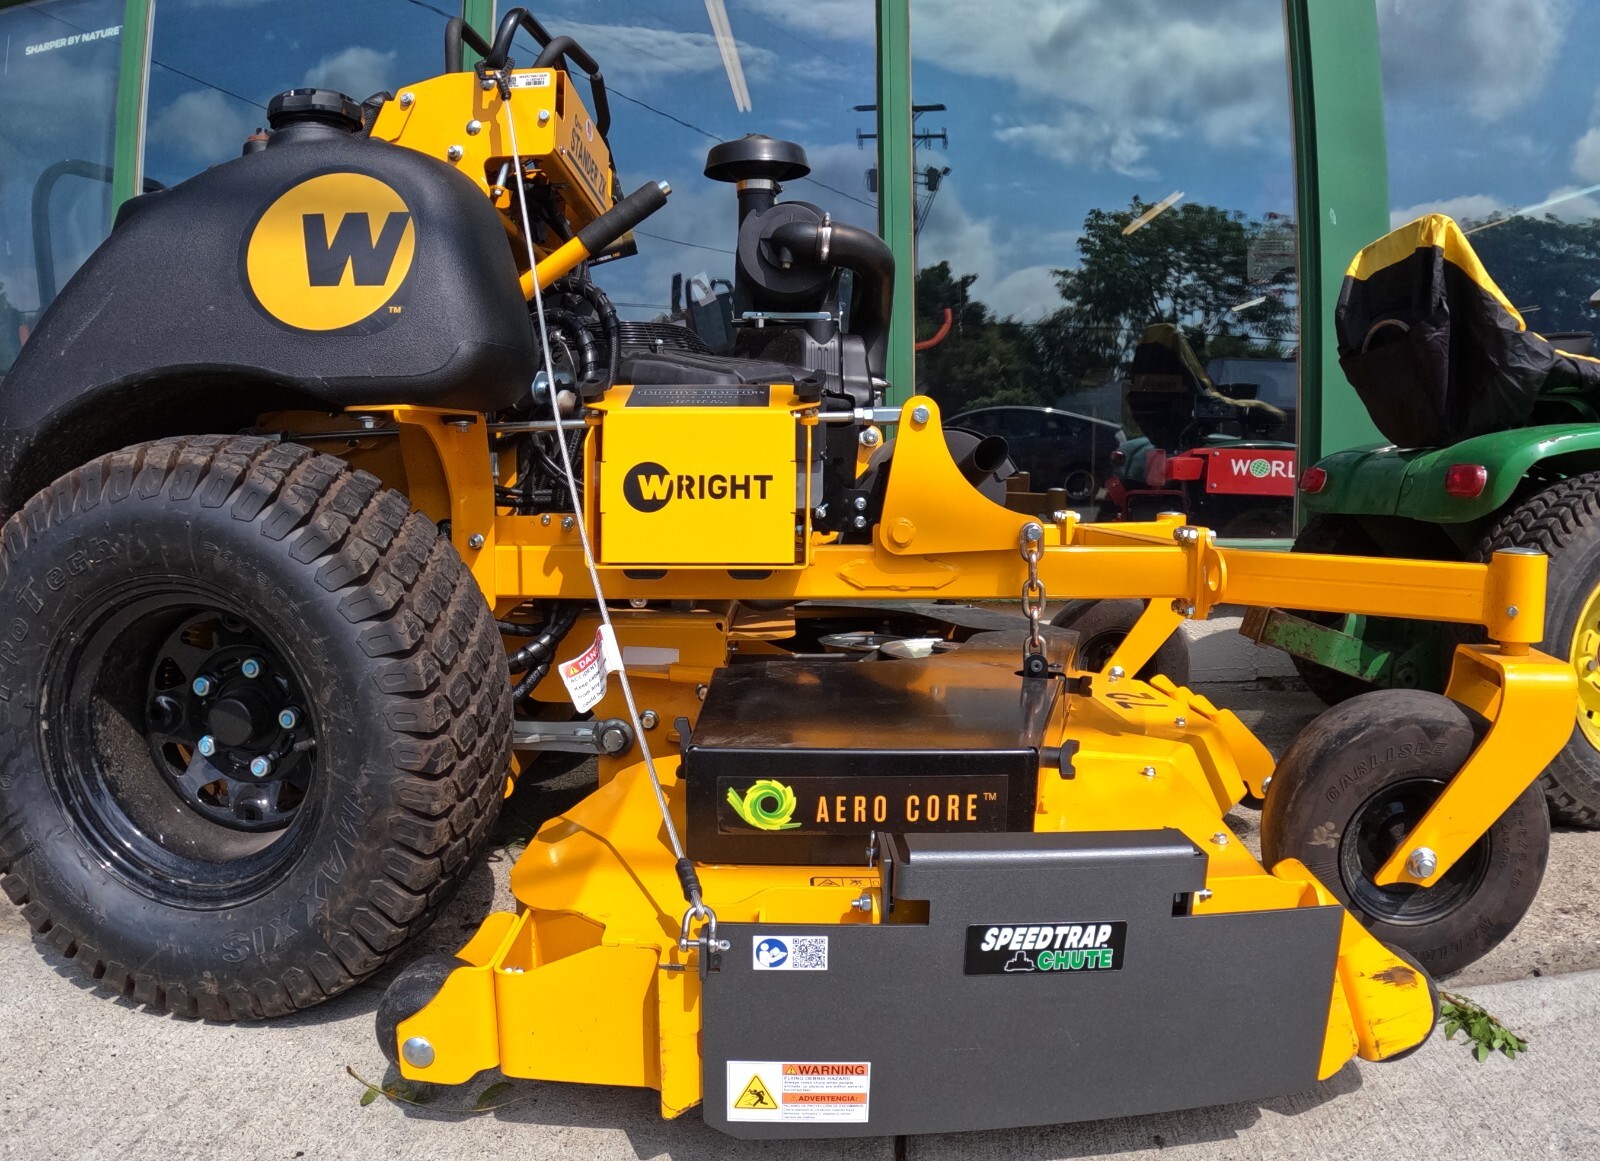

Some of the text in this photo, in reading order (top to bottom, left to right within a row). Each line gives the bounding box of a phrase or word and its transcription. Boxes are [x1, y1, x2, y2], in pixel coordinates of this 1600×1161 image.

[25, 26, 121, 56] SHARPER BY NATURE
[571, 127, 599, 188] STANDER
[302, 211, 410, 287] W
[634, 472, 774, 503] WRIGHT
[1325, 742, 1447, 803] CARLISLE
[816, 795, 887, 823] AERO
[906, 794, 978, 822] CORE
[980, 924, 1112, 951] SPEEDTRAP
[1037, 948, 1113, 971] CHUTE
[798, 1065, 865, 1075] WARNING
